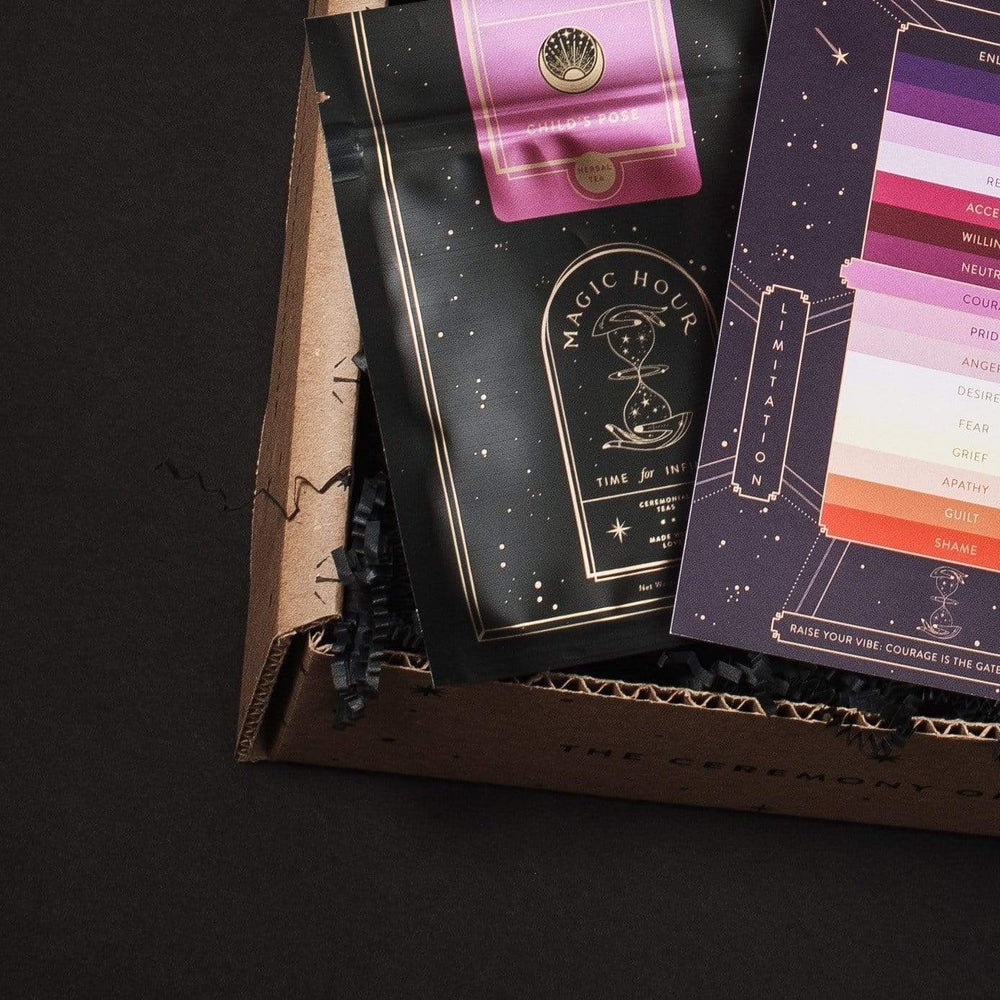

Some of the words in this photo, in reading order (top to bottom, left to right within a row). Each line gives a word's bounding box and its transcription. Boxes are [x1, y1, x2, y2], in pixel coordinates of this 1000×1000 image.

[598, 107, 640, 124] POSE
[578, 163, 612, 175] HERBAL
[588, 175, 604, 183] TEA
[563, 271, 618, 350] MAGIC
[633, 270, 698, 337] HOUR
[752, 302, 788, 487] LIMITATION
[957, 385, 1000, 404] DESIRE
[958, 418, 990, 434] FEAR
[952, 447, 988, 463] GRIEF
[596, 472, 629, 488] TIME
[638, 466, 655, 484] for
[941, 476, 990, 495] APATHY
[656, 504, 676, 513] TEAS
[944, 508, 979, 524] GUILT
[649, 533, 671, 544] MADE
[934, 537, 978, 556] SHAME
[790, 623, 820, 638] RAISE
[823, 630, 852, 645] YOUR
[886, 643, 938, 662] COURAGE
[941, 653, 951, 664] IS
[953, 656, 973, 669] THE
[559, 743, 643, 761] THE
[669, 756, 932, 793] CEREMONY
